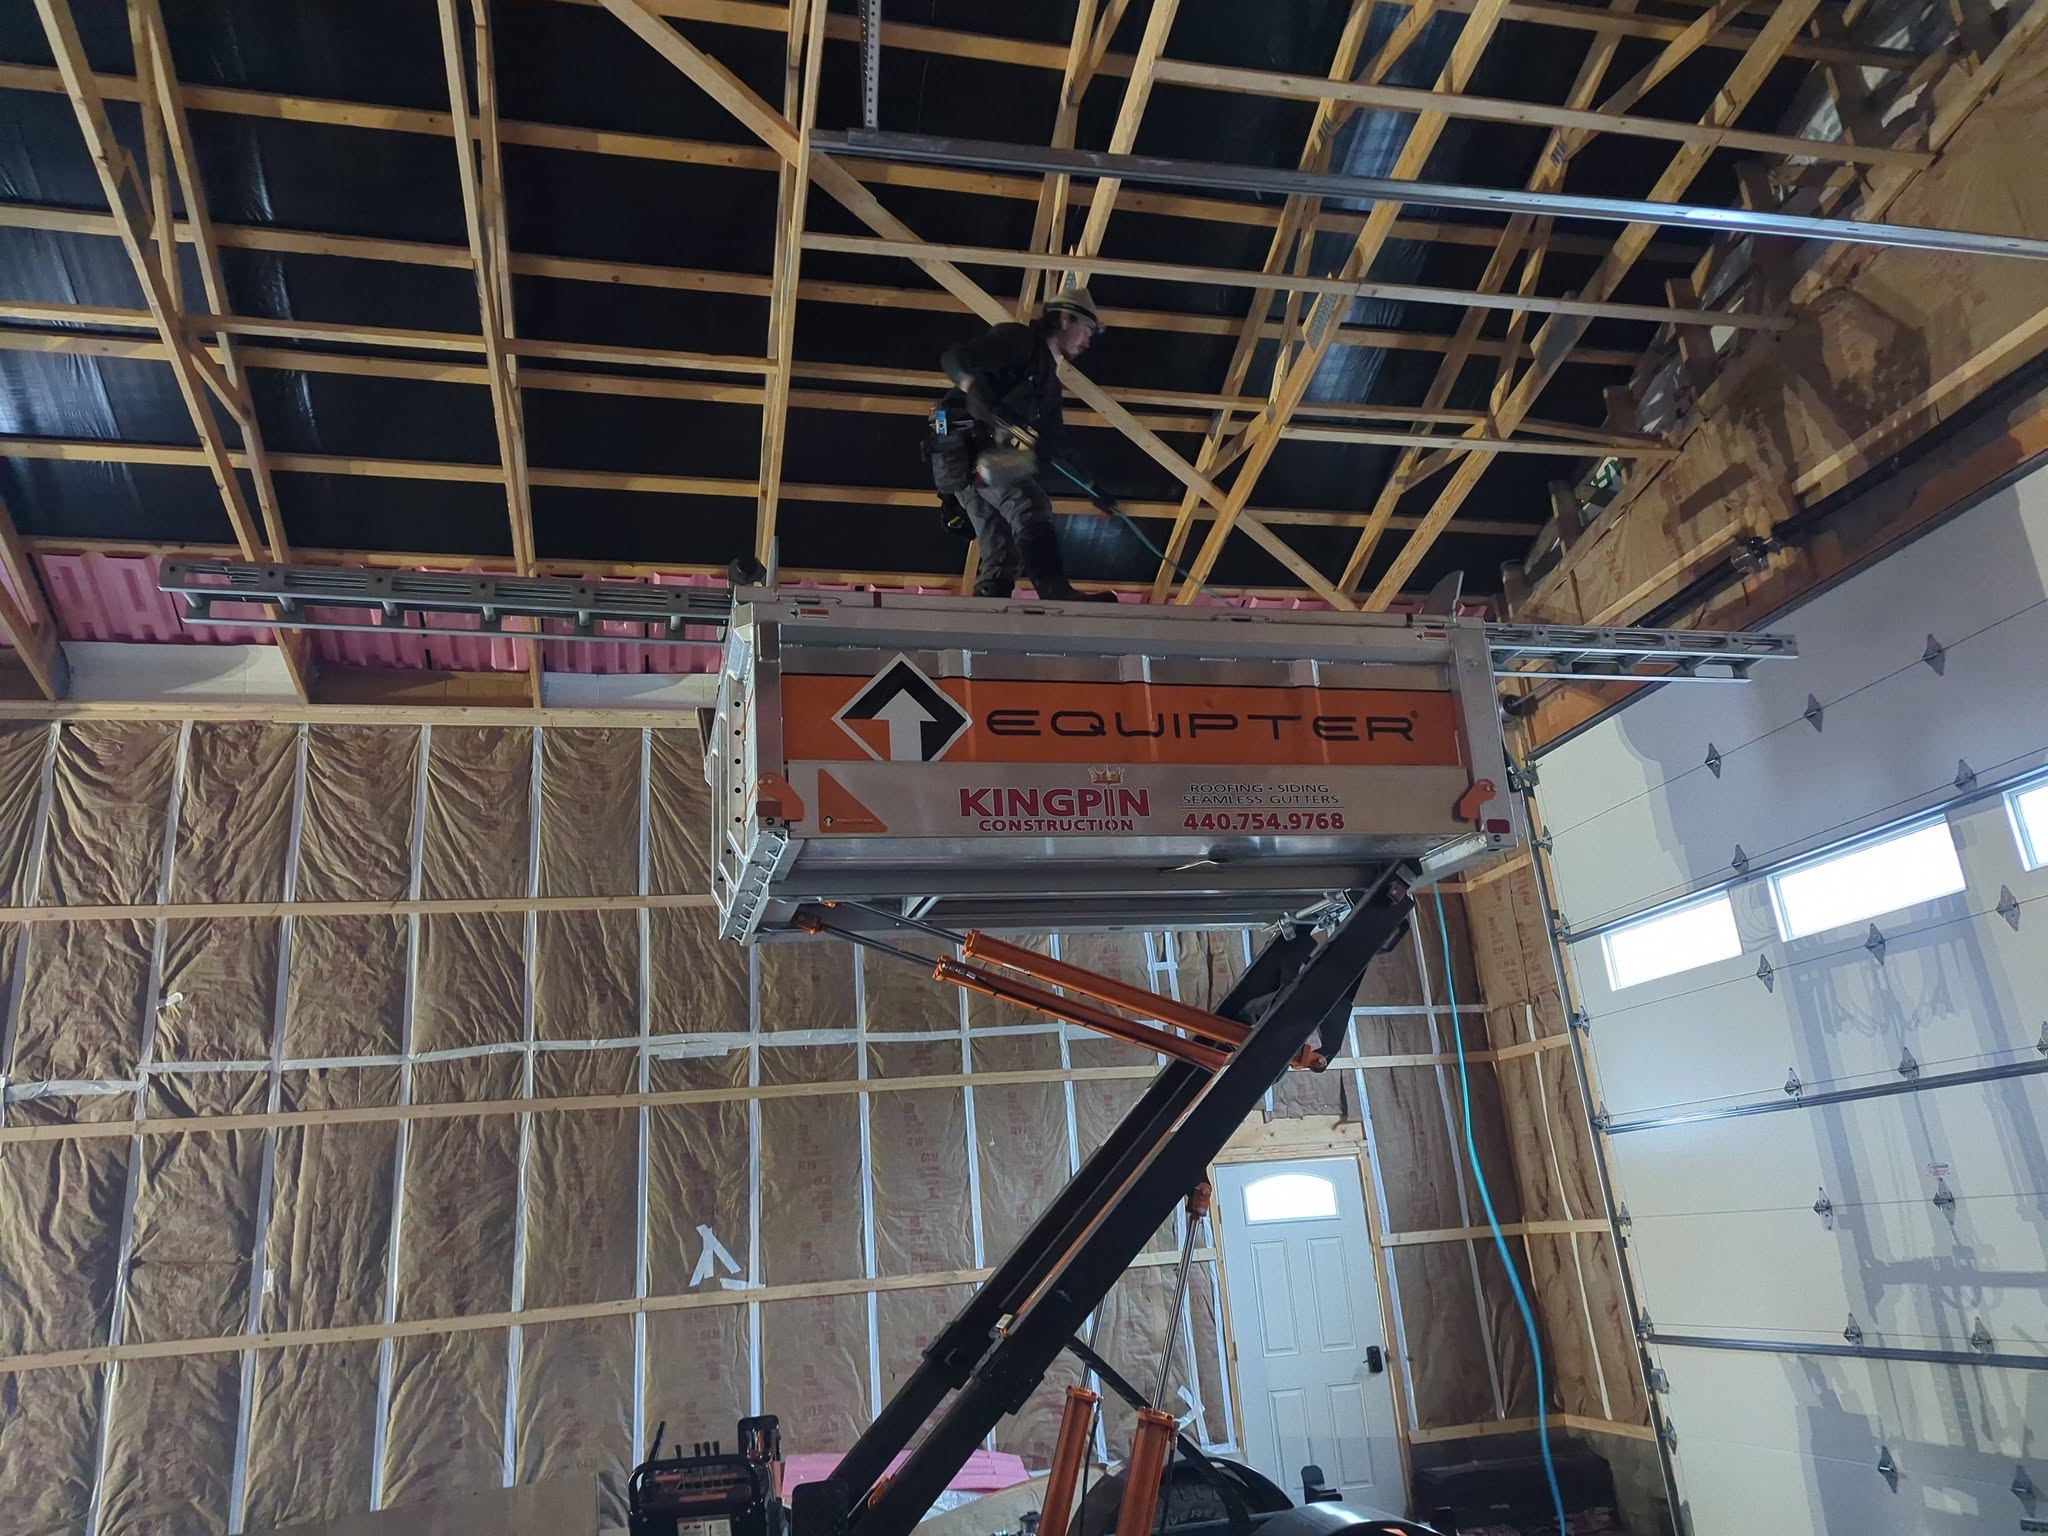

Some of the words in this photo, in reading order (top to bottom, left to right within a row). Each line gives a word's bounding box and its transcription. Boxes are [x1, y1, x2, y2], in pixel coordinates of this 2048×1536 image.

[986, 709, 1415, 742] EQUIPTER
[1190, 784, 1263, 793] ROOFING
[1277, 784, 1329, 793] SIDING
[959, 787, 1151, 817] KINGPIN
[1183, 795, 1263, 804] SEAMLESS
[1269, 795, 1339, 804] GUTTERS
[978, 819, 1134, 832] CONSTRUCTION
[1183, 812, 1345, 831] 440.754.9768
